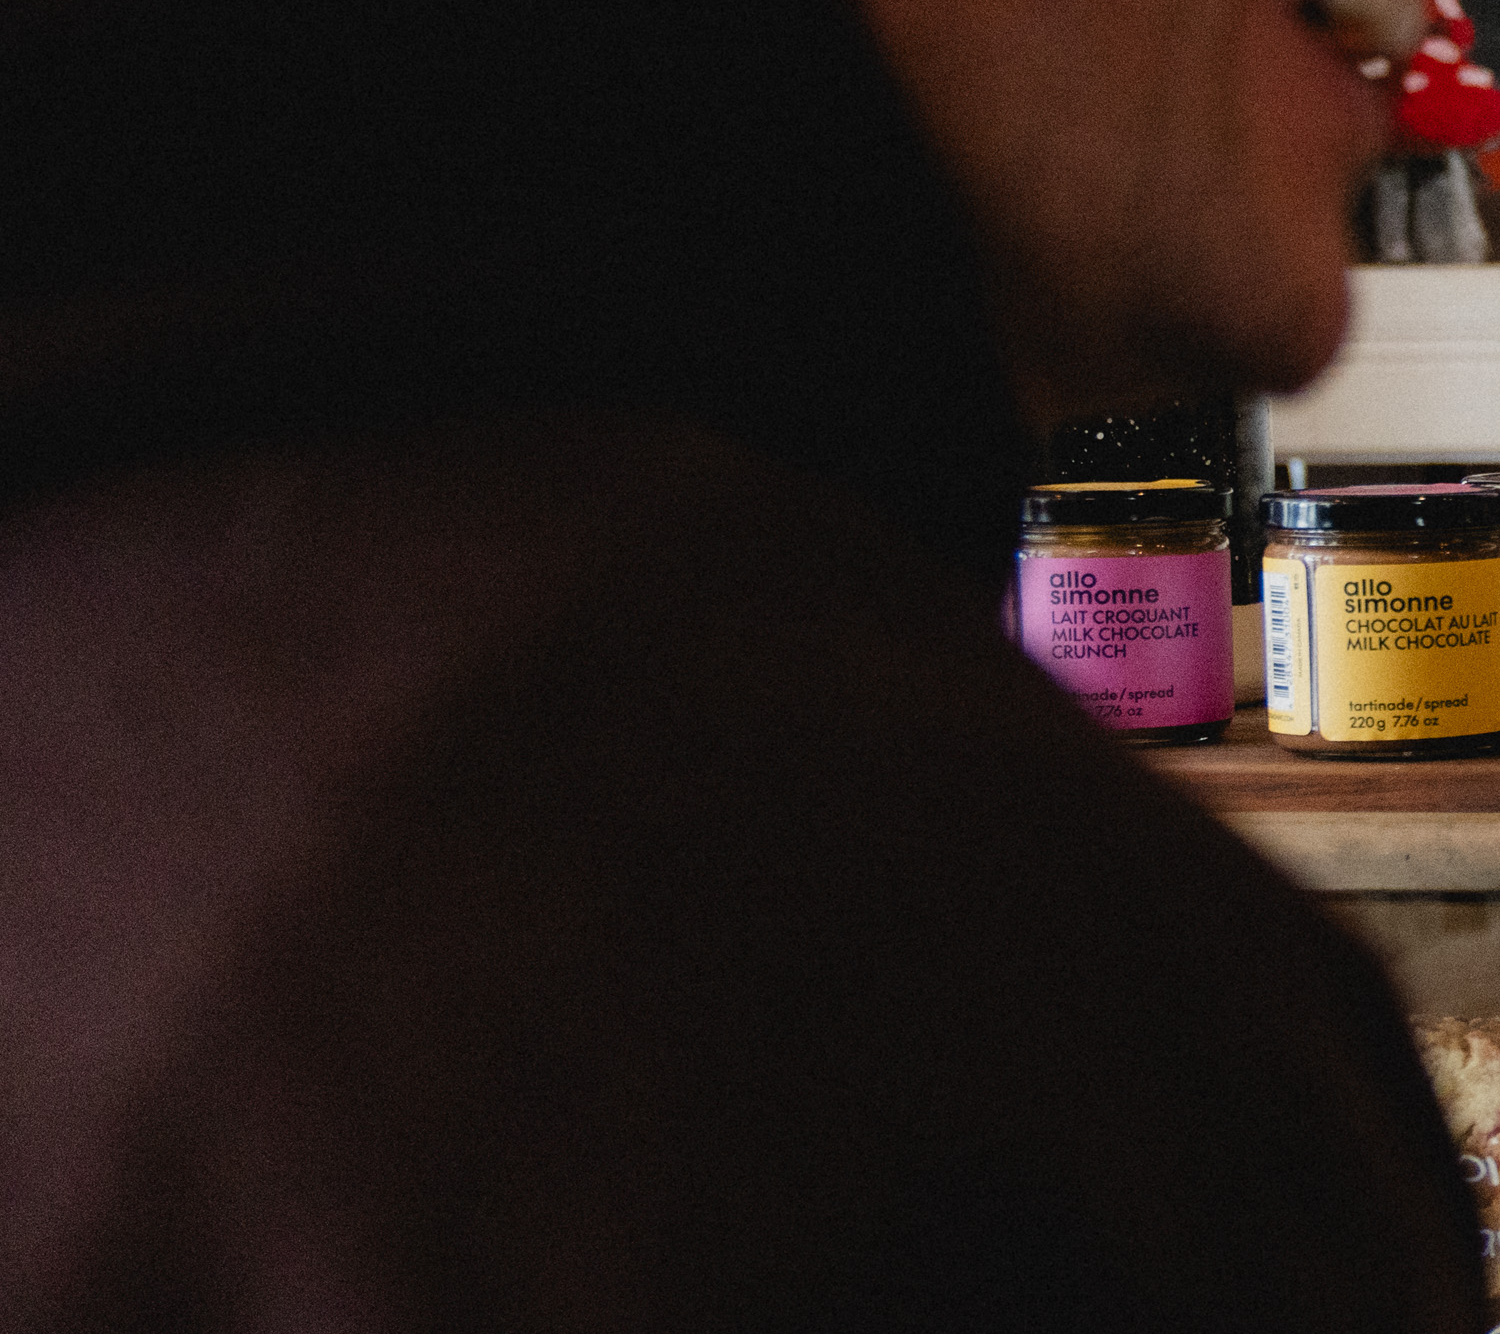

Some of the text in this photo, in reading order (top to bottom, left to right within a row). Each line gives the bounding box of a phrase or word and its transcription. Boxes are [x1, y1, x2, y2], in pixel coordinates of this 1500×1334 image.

[1050, 571, 1097, 588] allo
[1344, 579, 1392, 596] allo
[1050, 589, 1159, 605] simonne
[1345, 595, 1453, 613] simonne
[1052, 607, 1190, 624] LAIT CROQUANT
[1346, 612, 1498, 634] CHOCOLAT AU LAIT
[1052, 622, 1198, 642] MILK CHOCOLATE
[1347, 630, 1491, 651] MILK CHOCOLATE
[1052, 644, 1127, 659] CRUNCH
[1128, 706, 1143, 717] oz
[1423, 716, 1439, 726] oz
